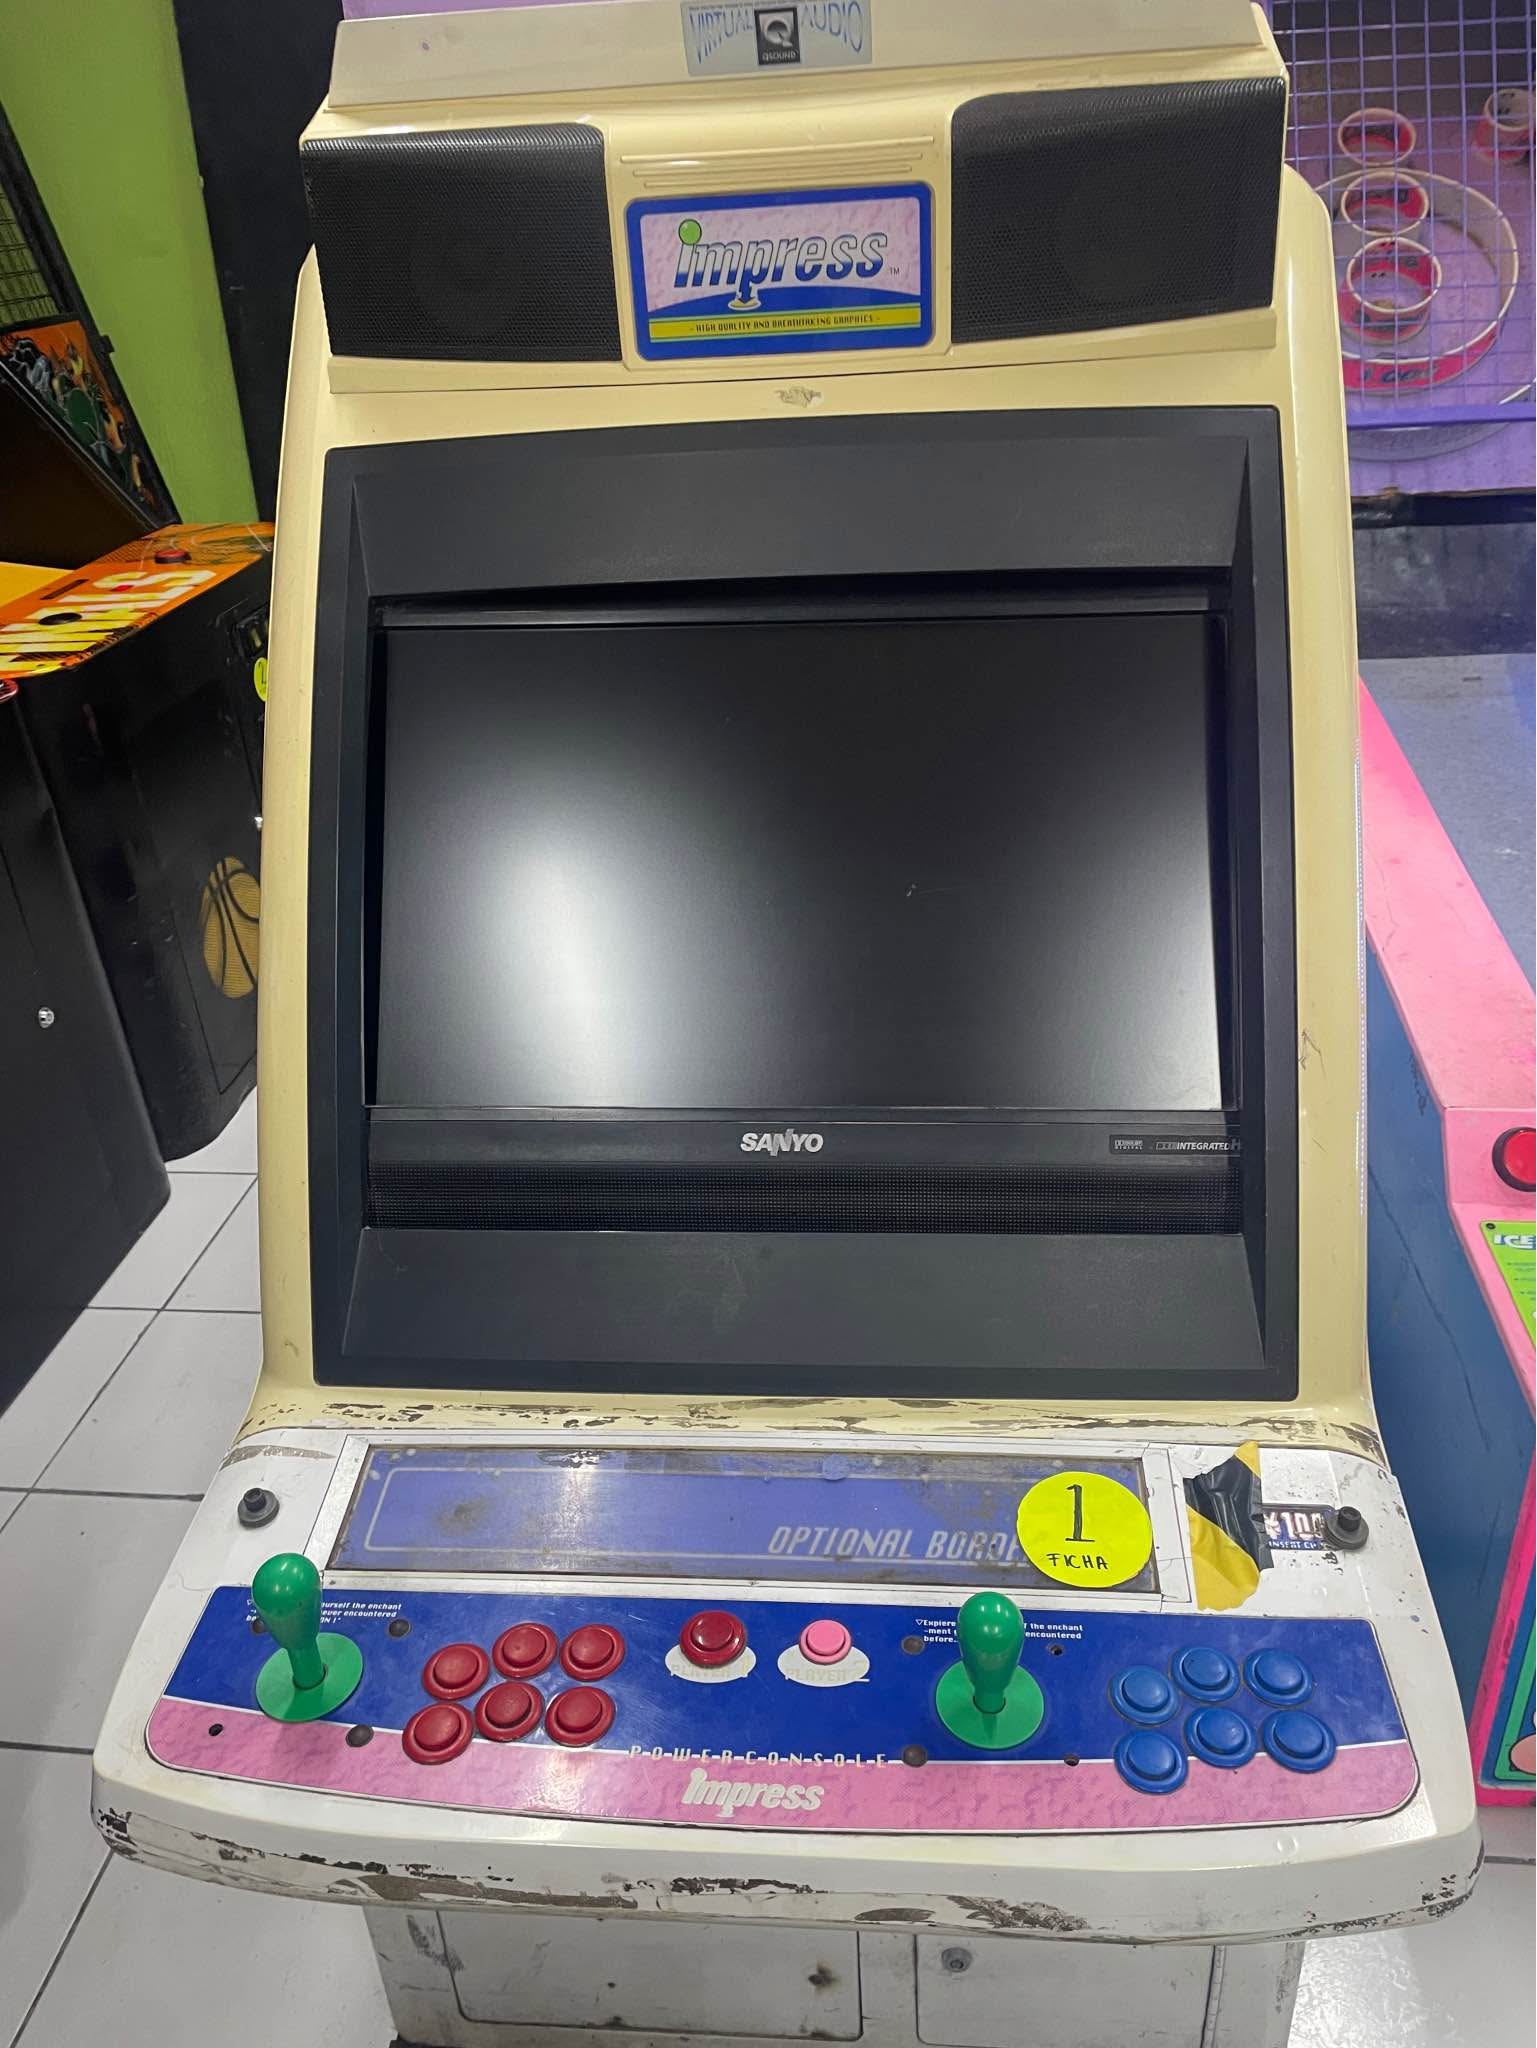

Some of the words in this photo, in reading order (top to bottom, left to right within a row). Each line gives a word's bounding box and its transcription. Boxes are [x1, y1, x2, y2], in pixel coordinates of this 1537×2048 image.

[689, 8, 753, 64] VIRTUAL
[801, 1, 863, 54] AUDIO
[674, 219, 888, 305] impress
[696, 323, 716, 333] HIGH
[718, 321, 751, 332] QUALITY
[753, 320, 769, 329] AND
[740, 1128, 824, 1157] SANYO
[1176, 1142, 1230, 1151] INTEGRATED
[1065, 1483, 1095, 1543] 1
[768, 1526, 913, 1557] OPTIONAL
[1046, 1553, 1109, 1570] FICHA
[343, 1610, 397, 1618] encountered
[368, 1602, 402, 1610] enchant
[1025, 1631, 1081, 1639] encountered
[681, 1768, 825, 1816] impress
